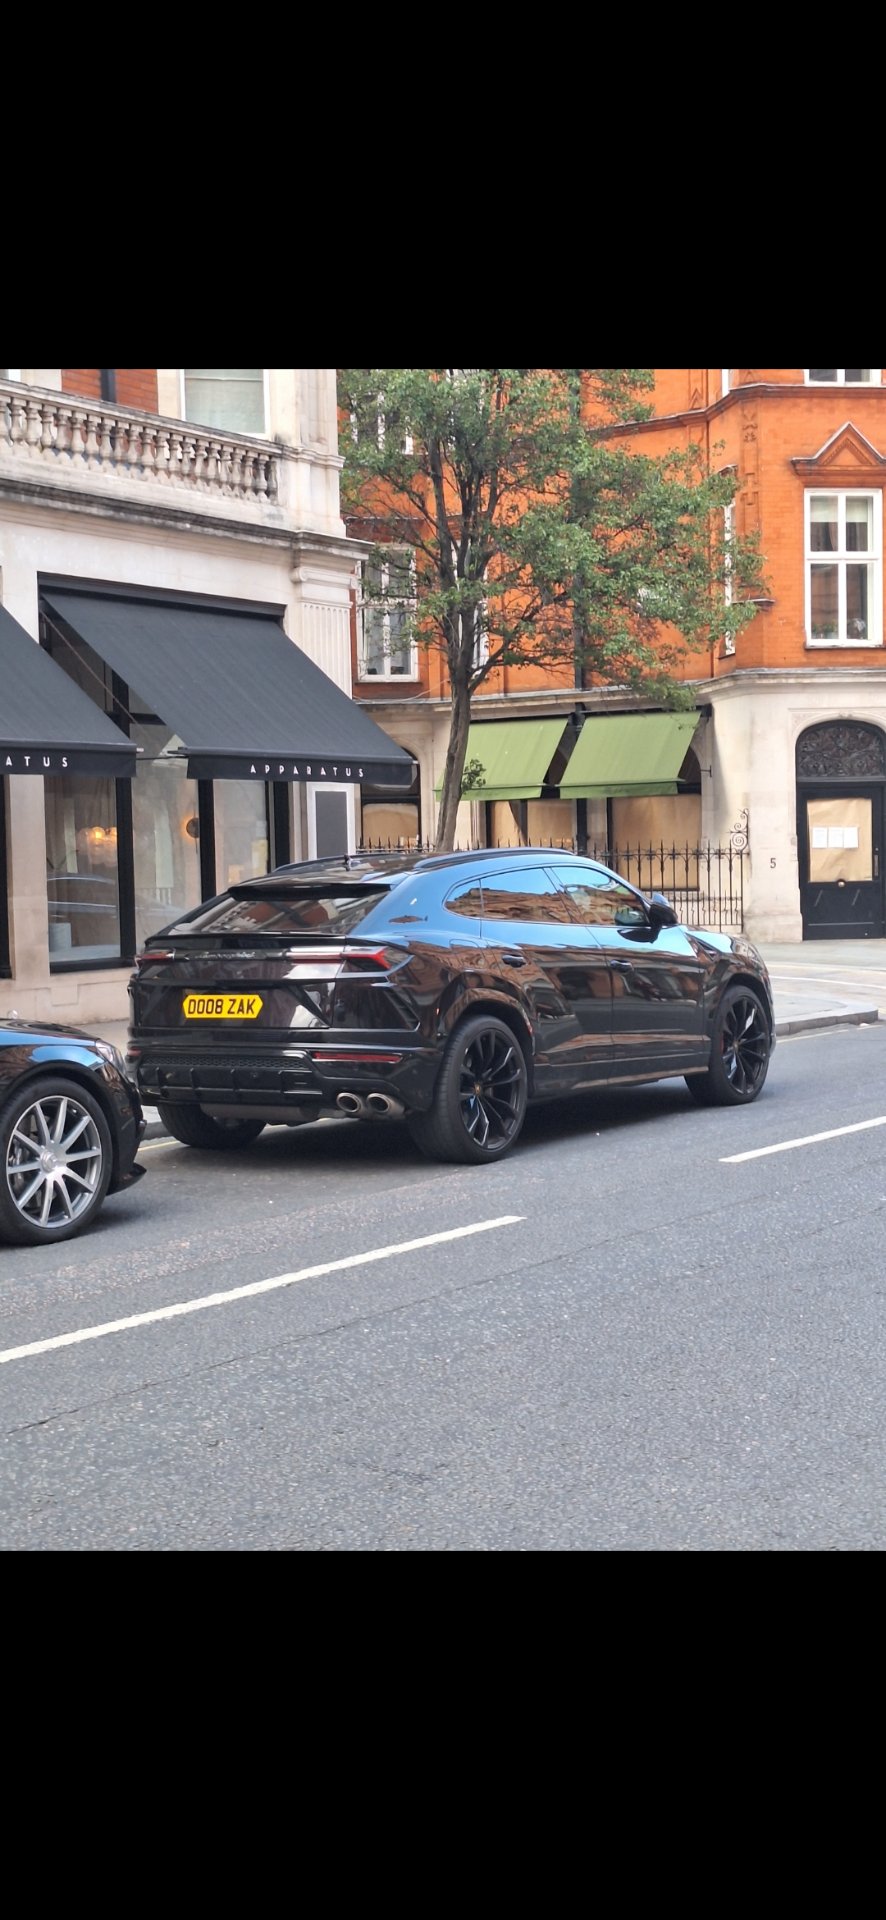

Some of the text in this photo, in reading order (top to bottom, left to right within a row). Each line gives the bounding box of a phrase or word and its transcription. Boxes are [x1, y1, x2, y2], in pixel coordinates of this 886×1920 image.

[5, 755, 68, 768] ATUS
[250, 764, 363, 778] APPARATUS
[770, 857, 777, 869] 5
[227, 998, 256, 1015] ZAK
